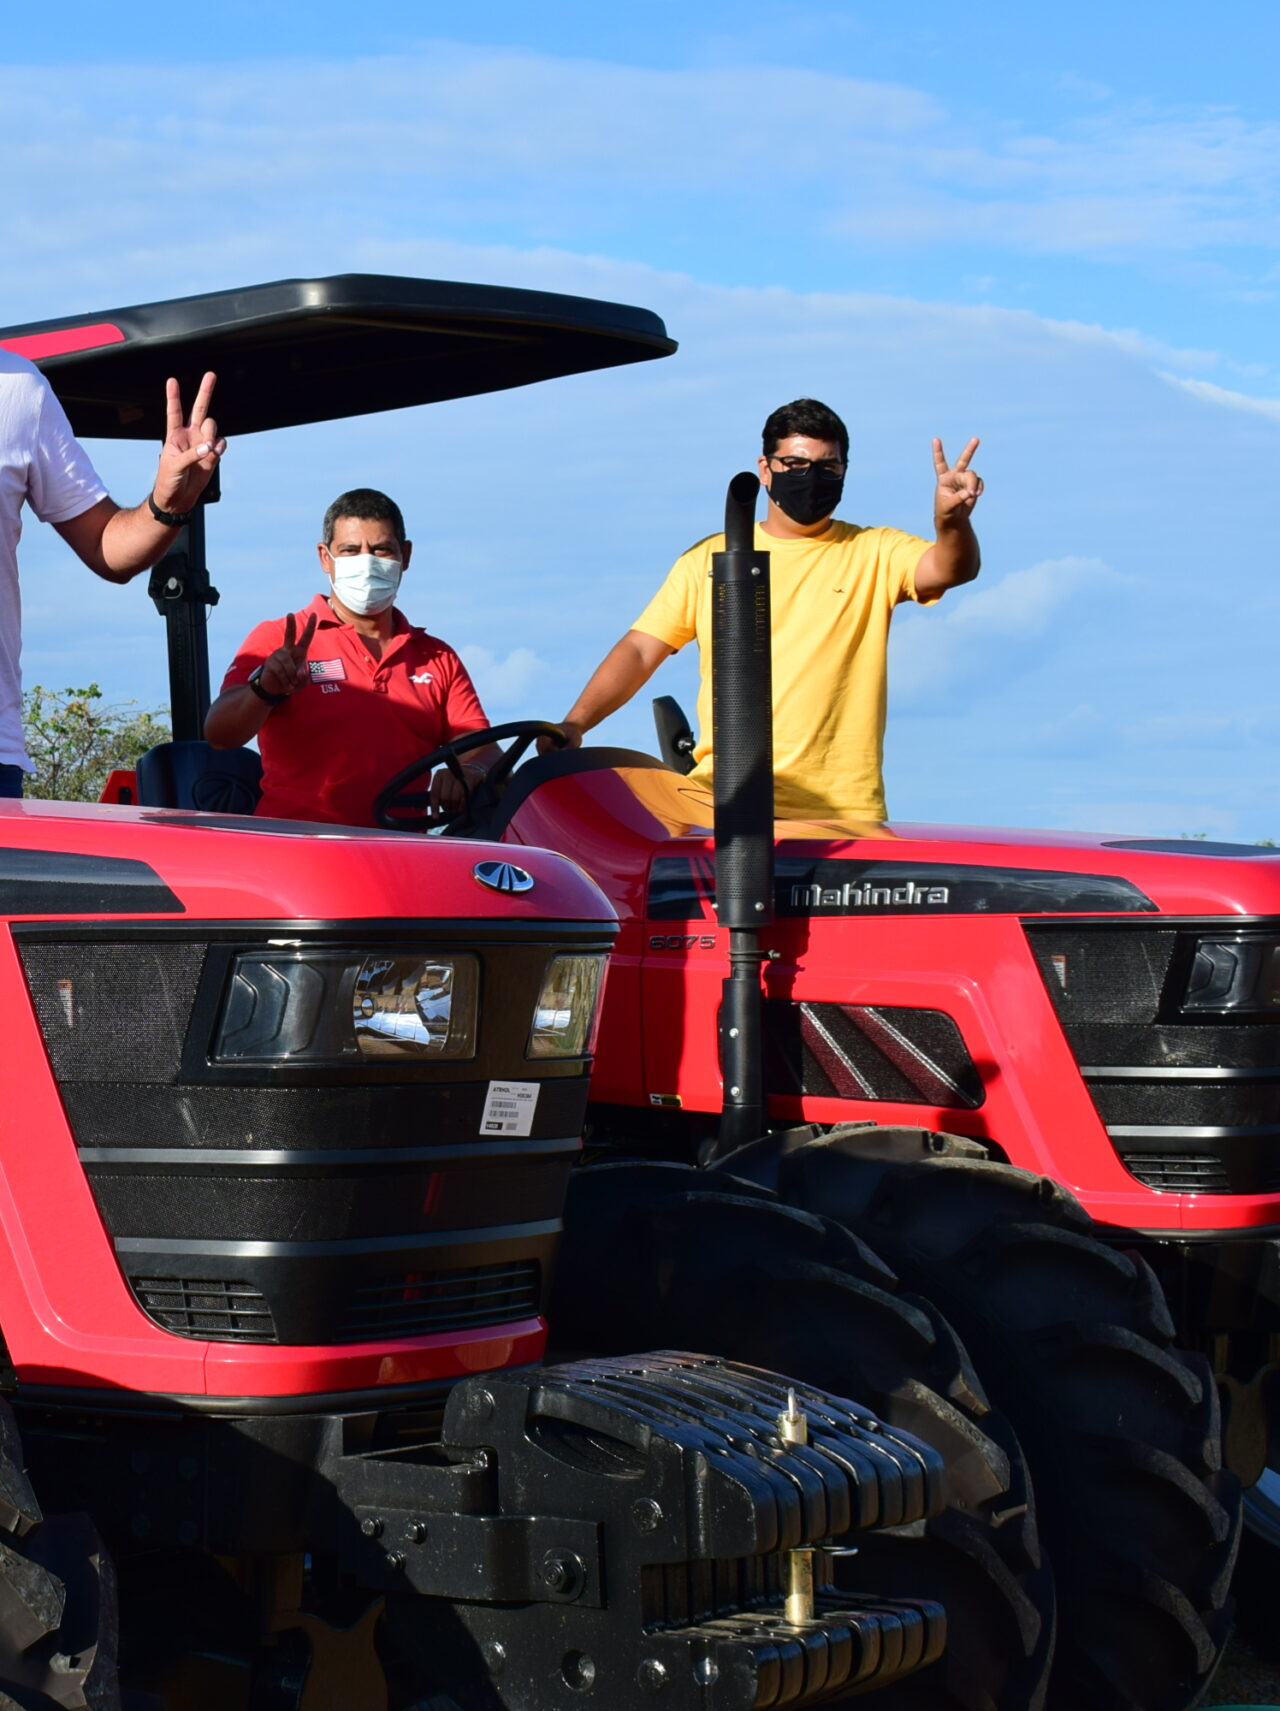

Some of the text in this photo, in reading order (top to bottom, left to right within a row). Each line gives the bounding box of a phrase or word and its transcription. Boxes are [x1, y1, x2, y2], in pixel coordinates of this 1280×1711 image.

[320, 684, 340, 694] USA
[790, 881, 950, 907] Mahindra
[648, 934, 717, 950] 6075
